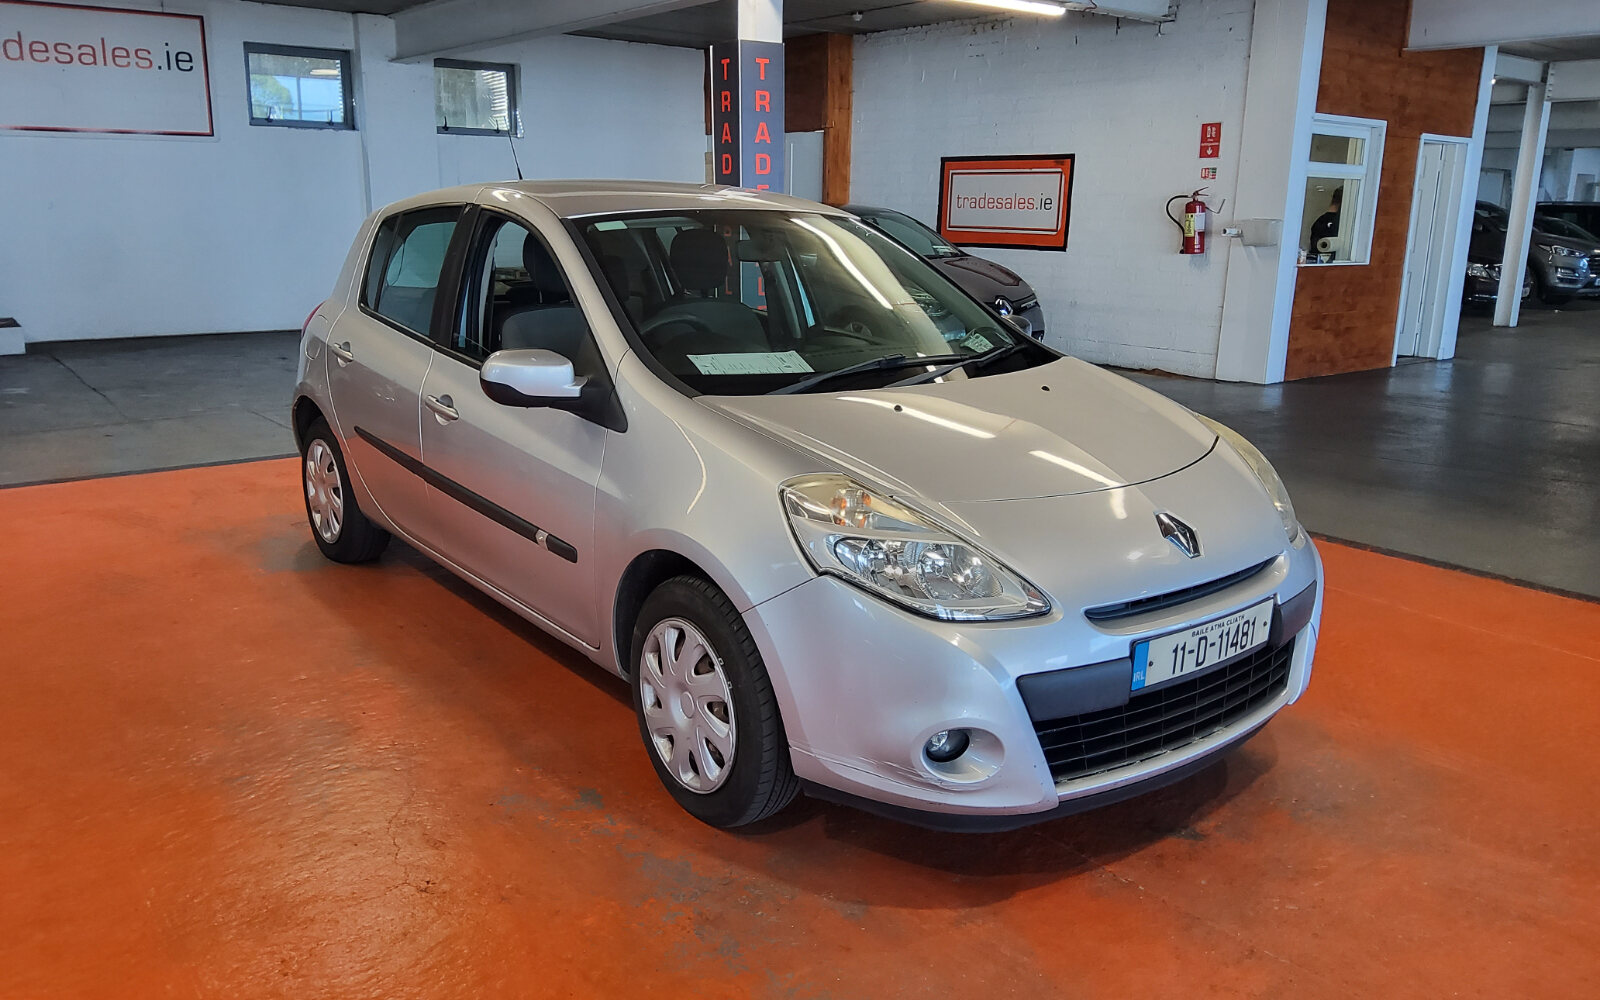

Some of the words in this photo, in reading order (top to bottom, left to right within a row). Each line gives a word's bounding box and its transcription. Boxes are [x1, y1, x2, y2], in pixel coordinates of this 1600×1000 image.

[1, 31, 194, 72] desales.ie
[754, 57, 772, 191] TRAD
[956, 192, 1053, 211] tradesales.ie
[1191, 626, 1209, 638] BAILE
[1226, 614, 1245, 626] CLIATH
[1172, 616, 1257, 675] 11-D-11481
[1133, 670, 1145, 682] IRL
